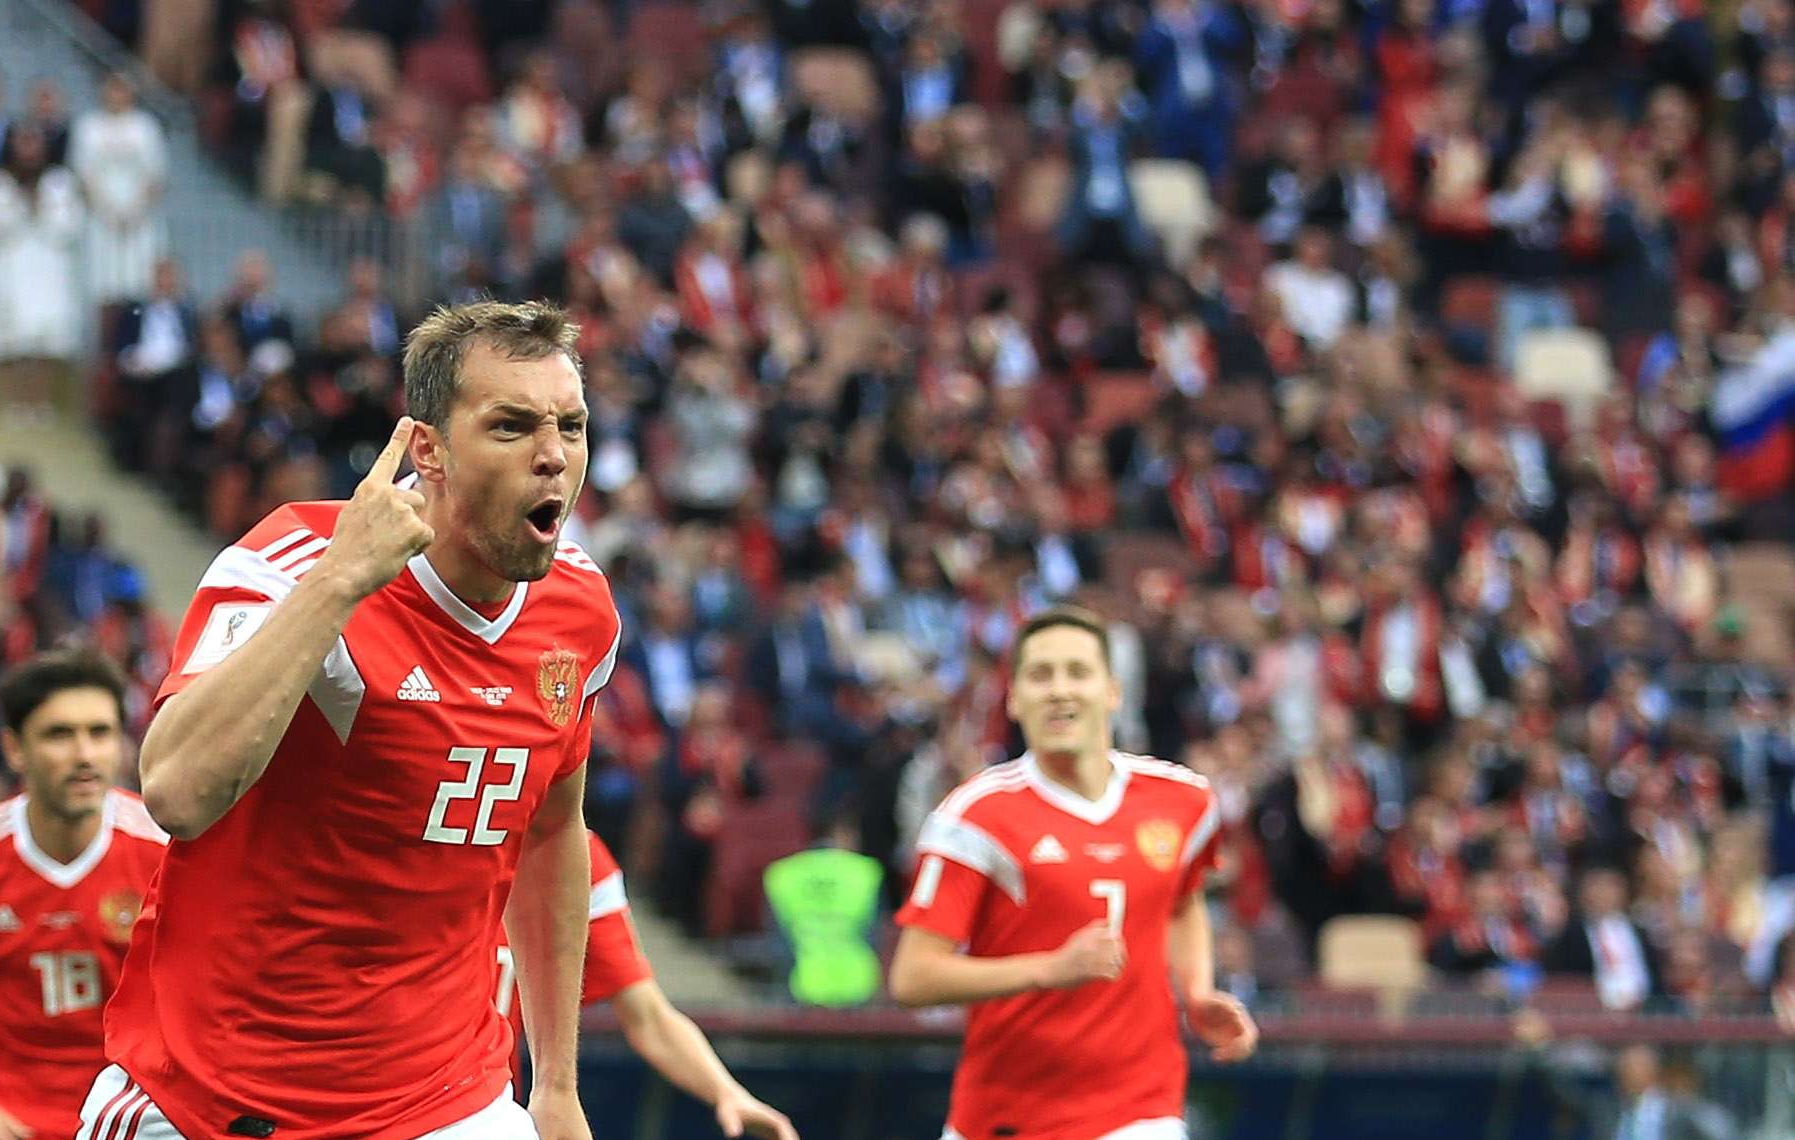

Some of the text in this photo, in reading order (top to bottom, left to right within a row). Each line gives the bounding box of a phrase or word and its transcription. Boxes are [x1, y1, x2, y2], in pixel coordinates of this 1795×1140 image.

[397, 687, 441, 702] adidas
[422, 746, 530, 846] 22
[29, 951, 102, 1017] 18
